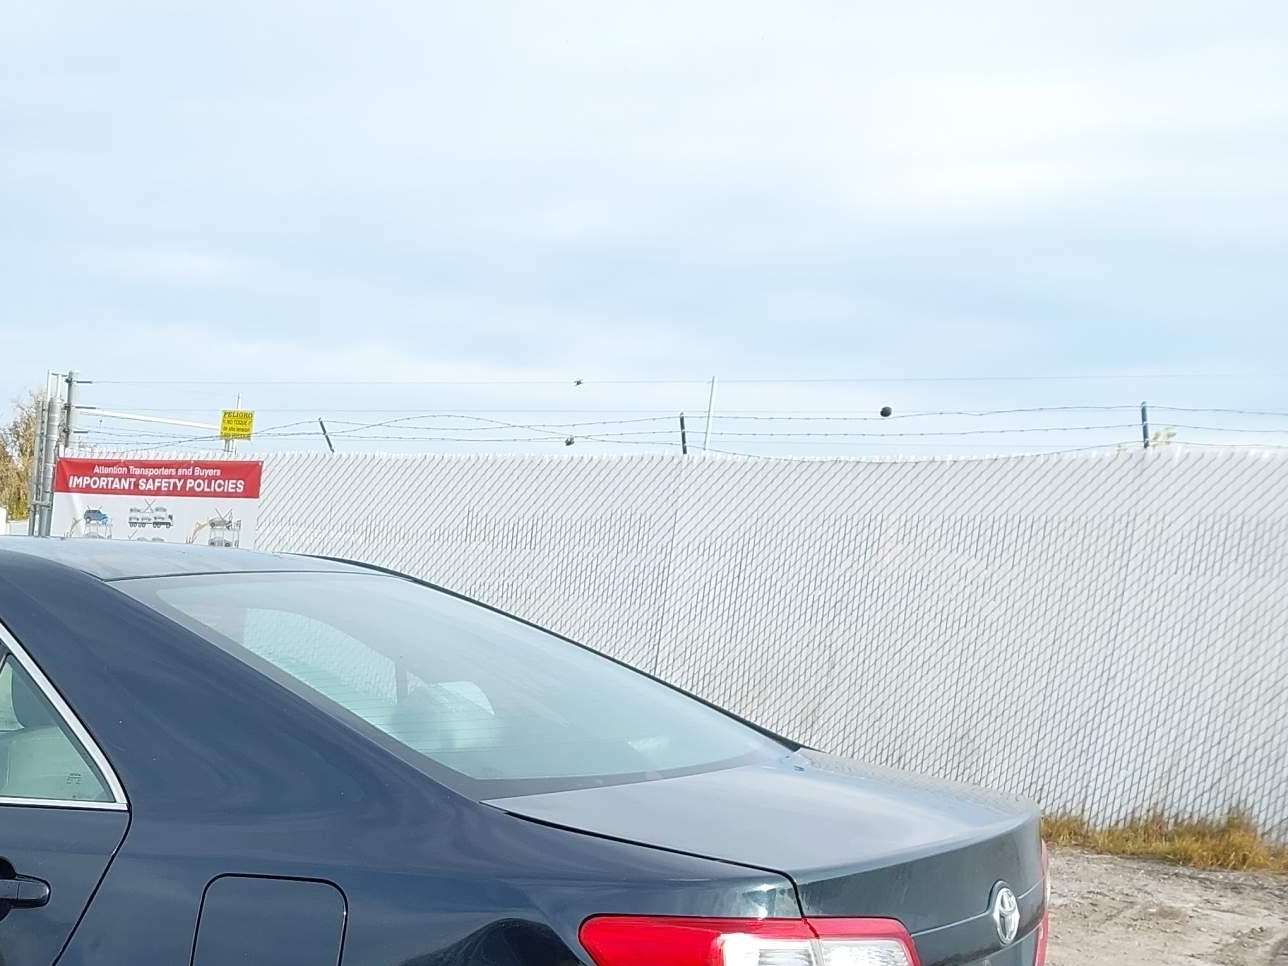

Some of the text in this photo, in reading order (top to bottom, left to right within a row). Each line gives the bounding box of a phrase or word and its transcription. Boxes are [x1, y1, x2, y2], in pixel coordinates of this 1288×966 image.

[93, 464, 221, 478] Attention Transporters and Buyers
[69, 476, 245, 493] IMPORTANT SAFETY POLICIES
